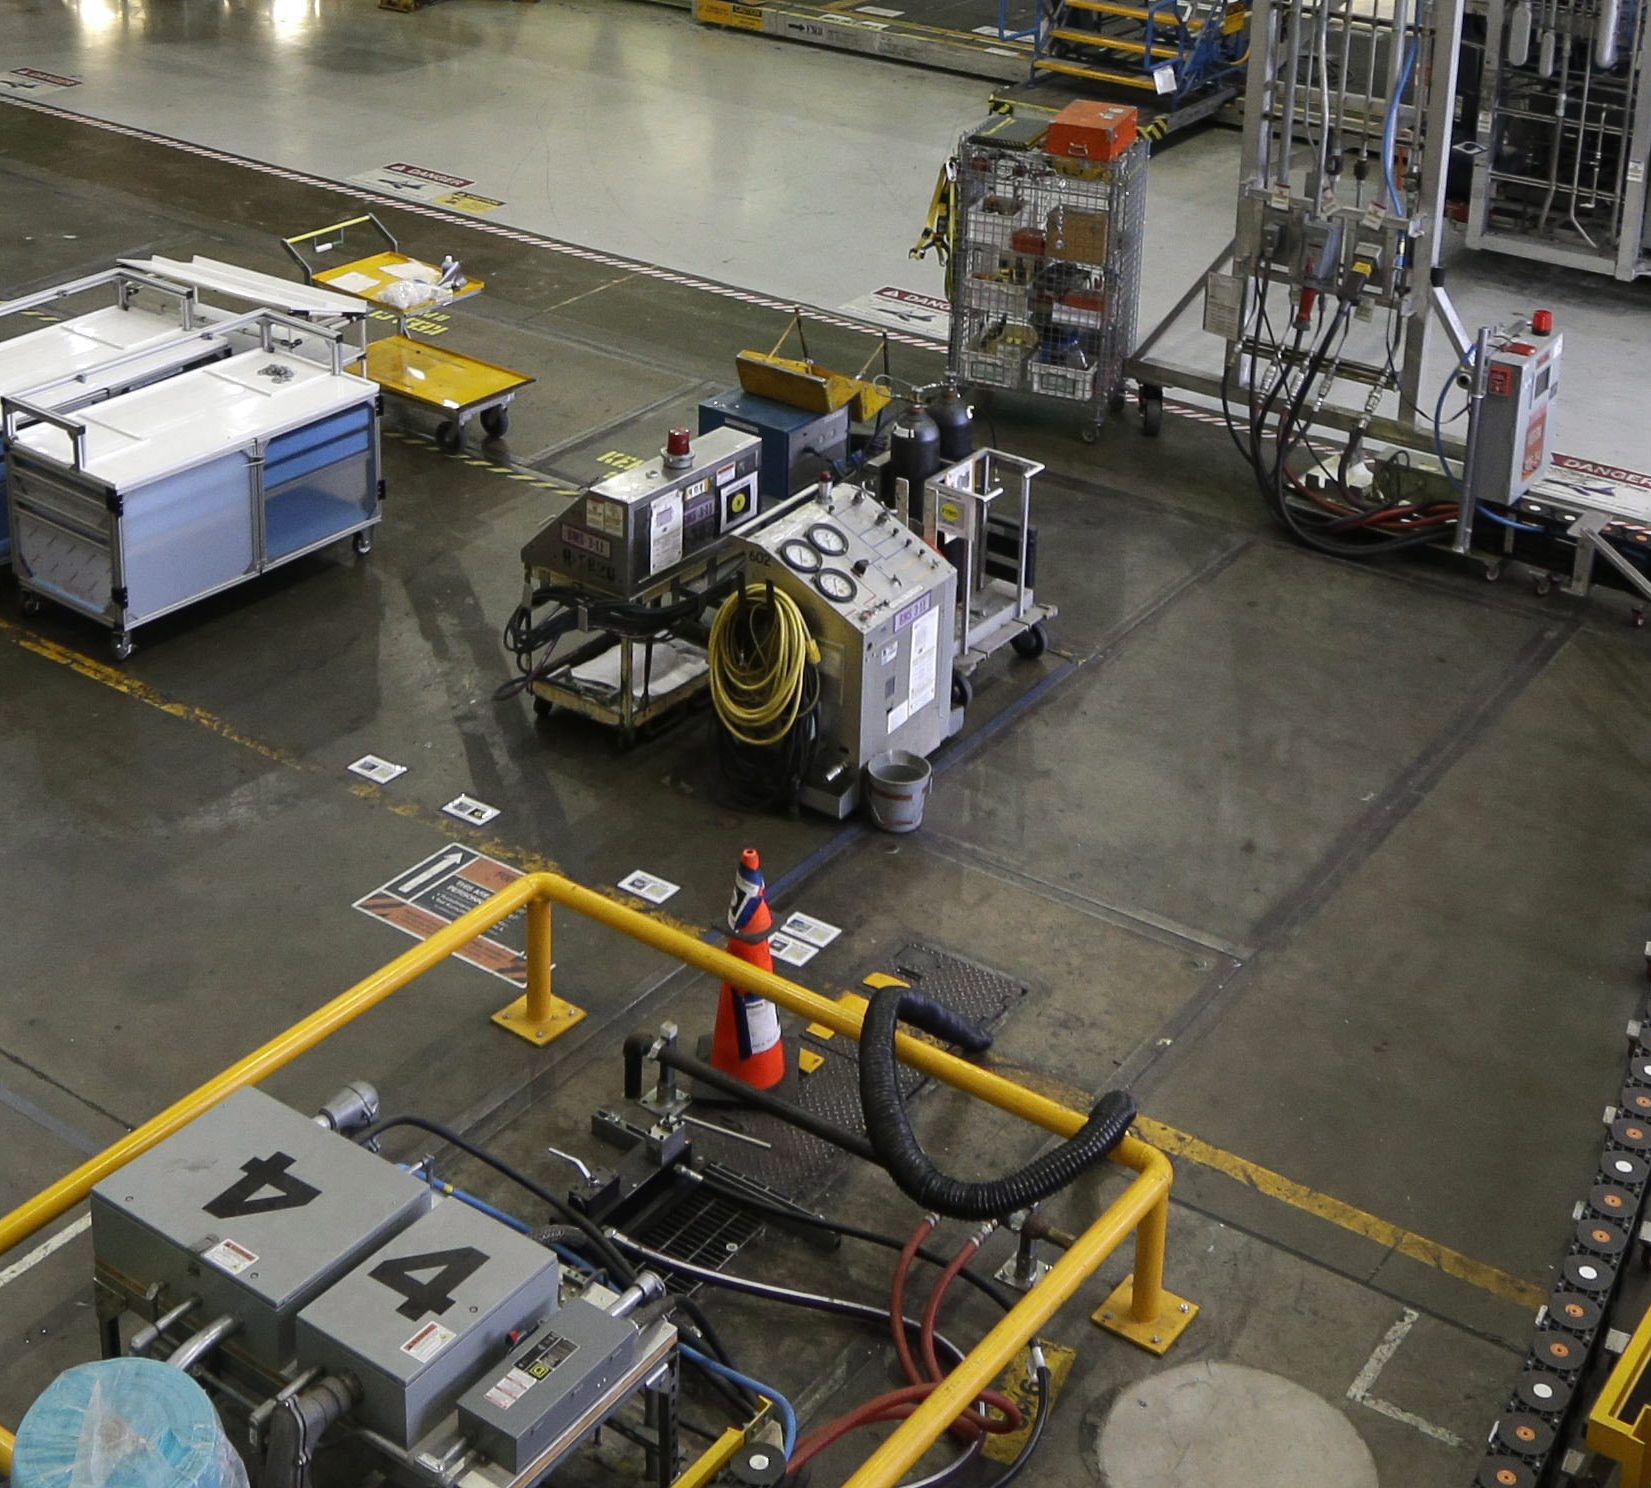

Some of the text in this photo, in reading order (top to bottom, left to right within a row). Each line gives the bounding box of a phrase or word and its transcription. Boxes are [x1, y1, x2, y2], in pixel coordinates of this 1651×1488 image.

[903, 294, 952, 311] DANG
[202, 1151, 322, 1219] 4
[367, 1246, 491, 1322] 4
